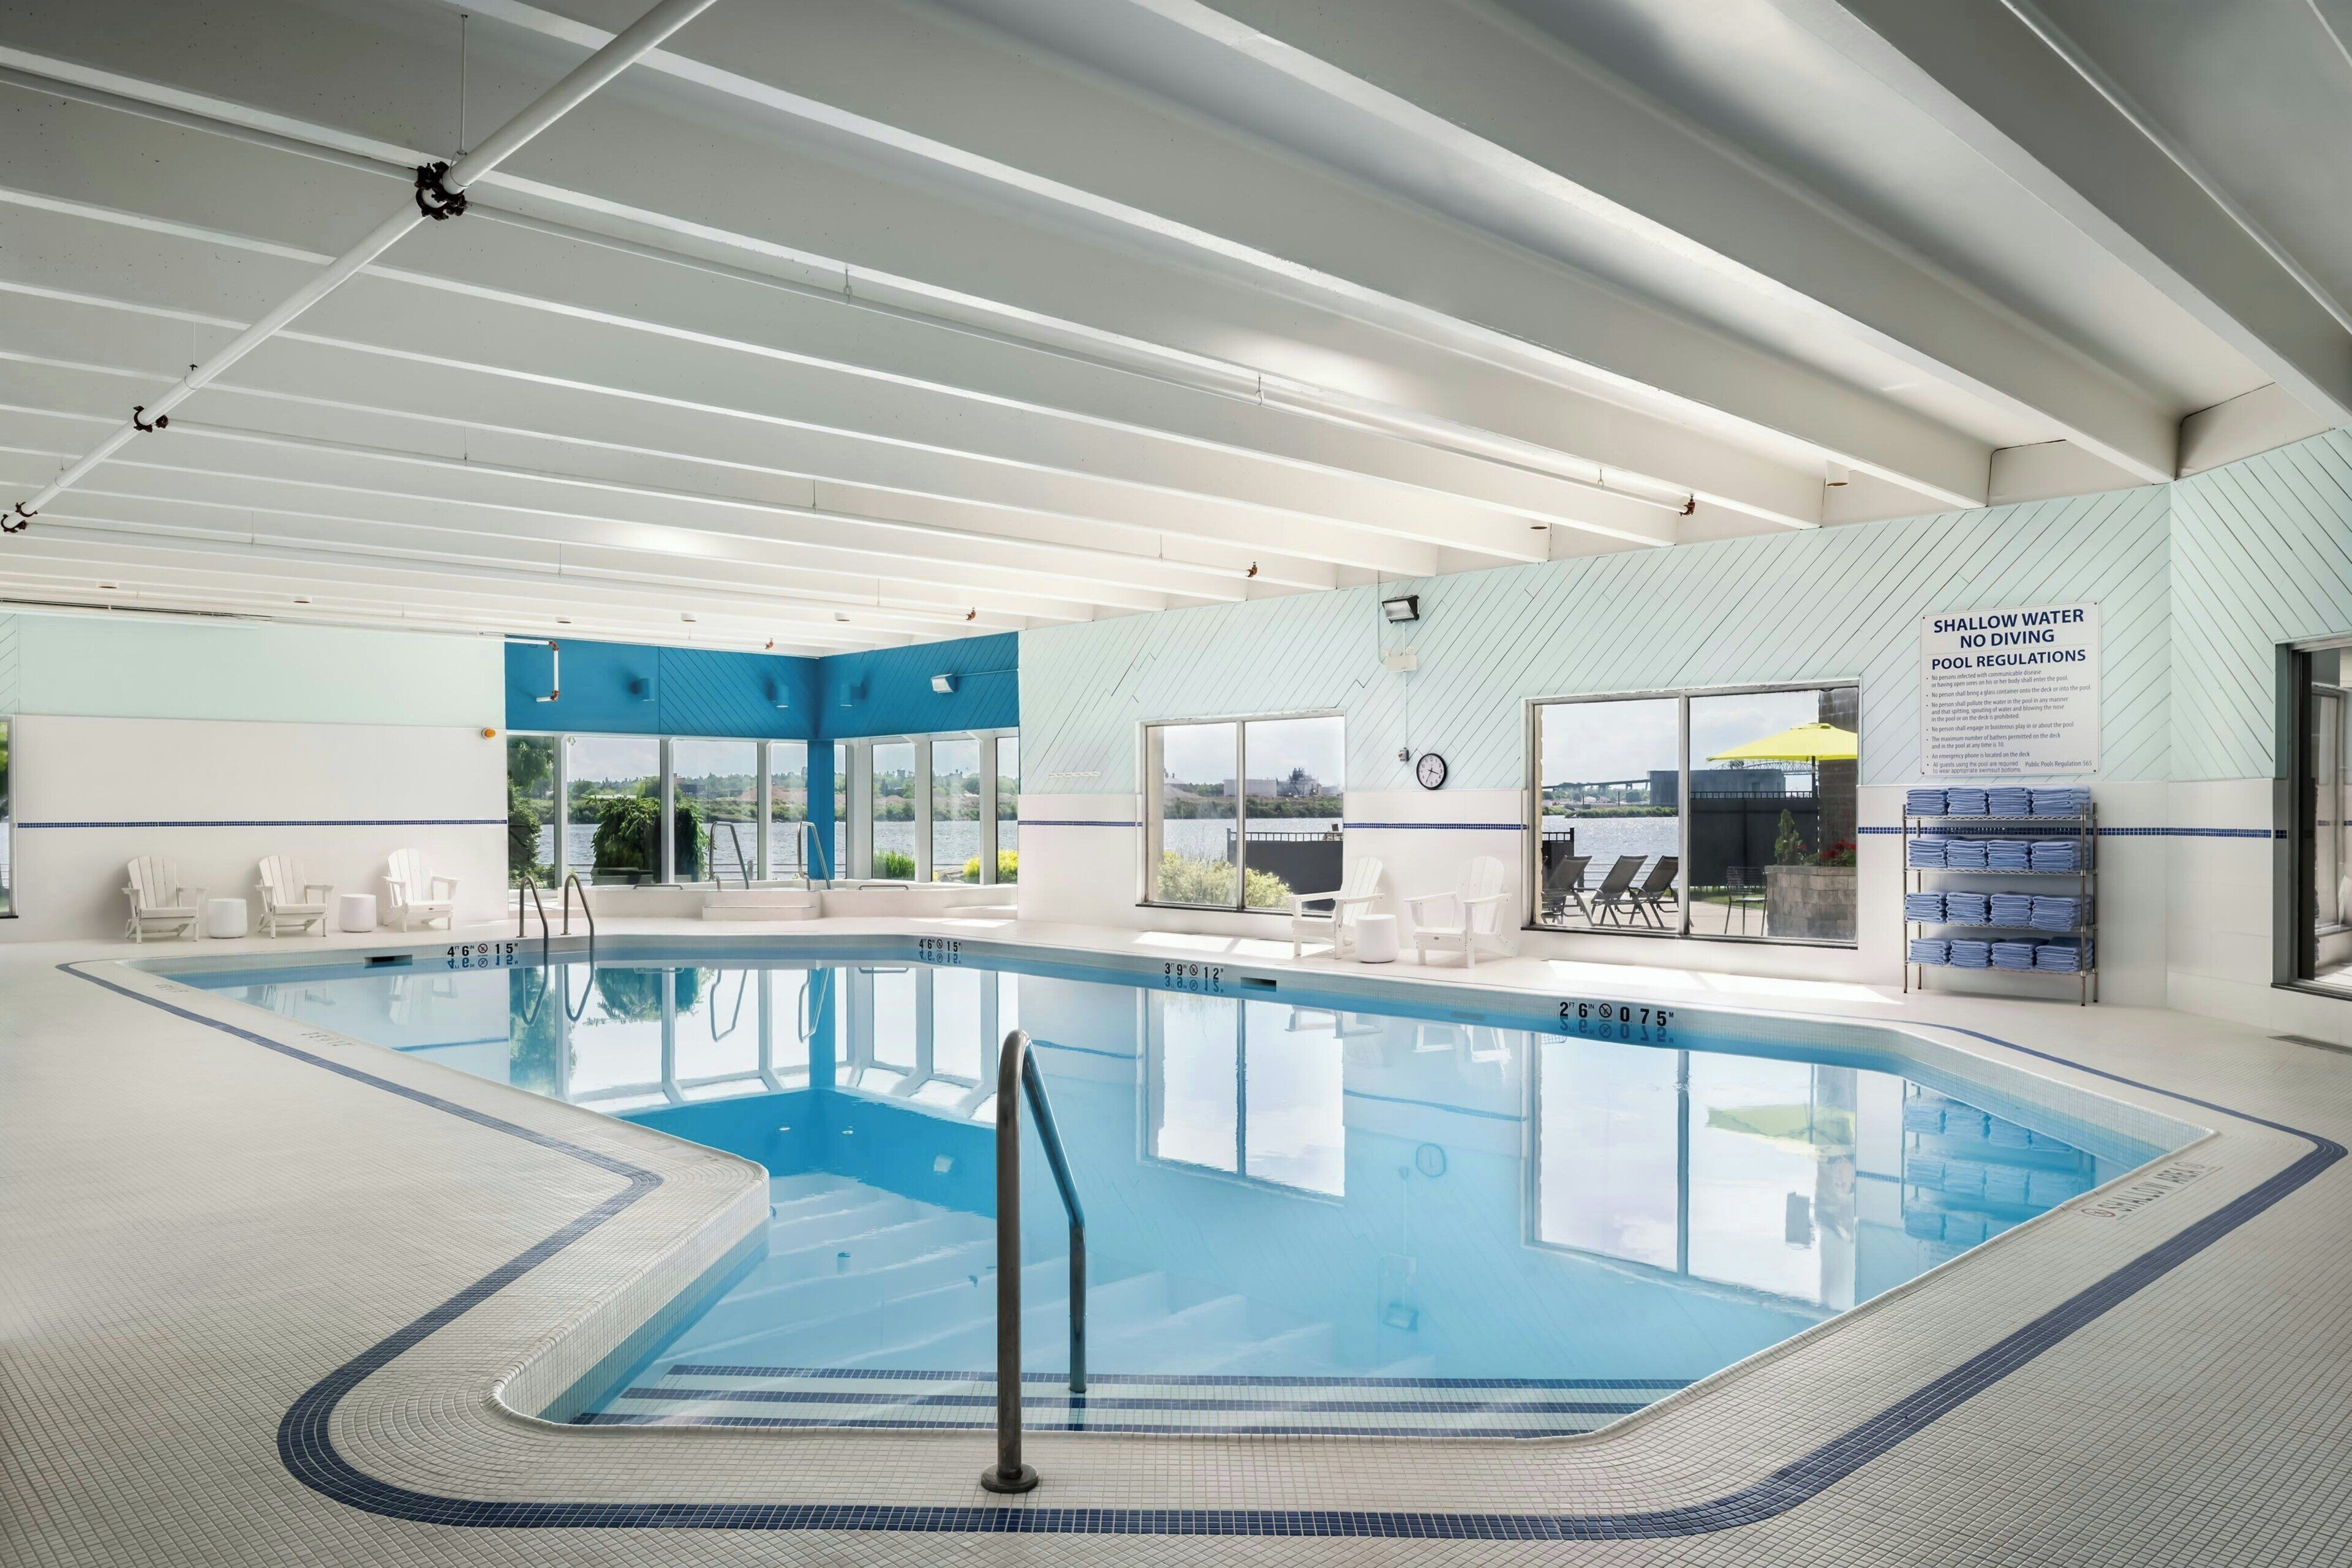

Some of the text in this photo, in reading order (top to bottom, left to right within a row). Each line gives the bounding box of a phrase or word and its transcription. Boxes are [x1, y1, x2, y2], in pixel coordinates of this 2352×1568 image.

[1934, 609, 2084, 633] SHALLOW WATER
[1961, 629, 2054, 648] NO DIVING
[1932, 649, 2086, 670] POOL REGULATIONS
[2097, 1167, 2204, 1212] SHALLOW AREA
